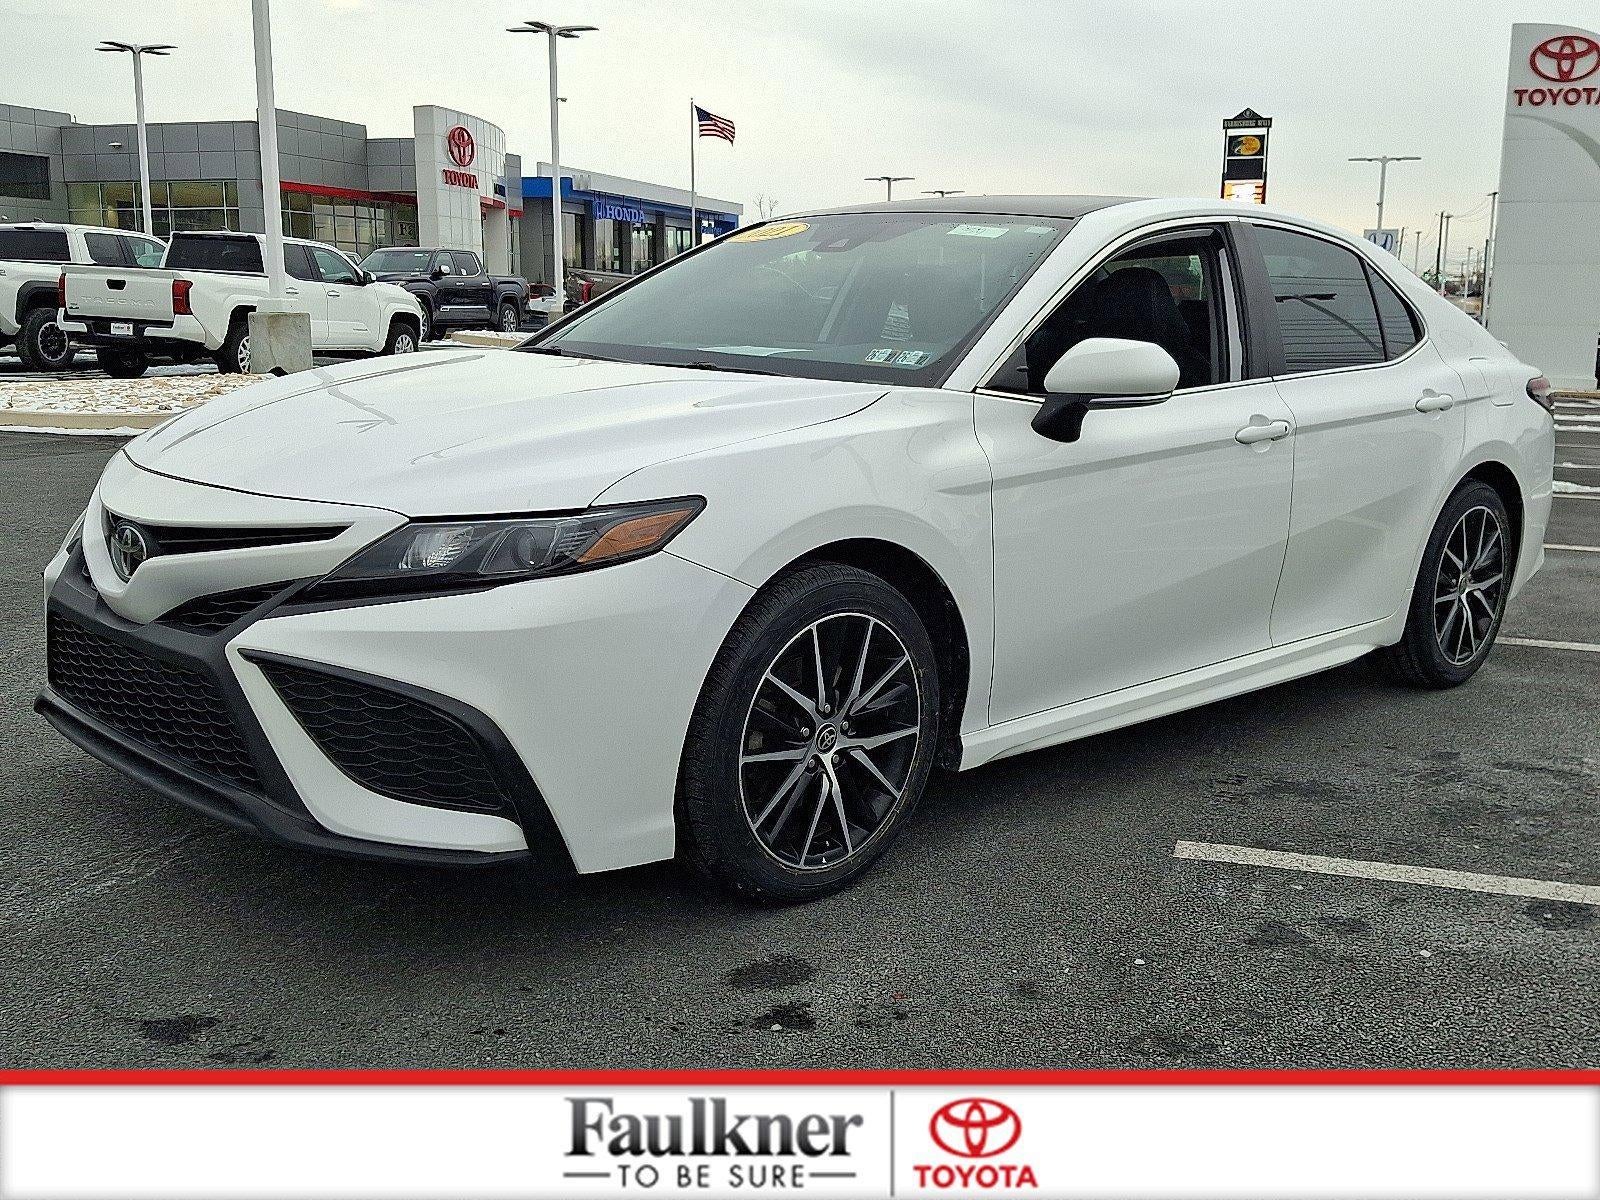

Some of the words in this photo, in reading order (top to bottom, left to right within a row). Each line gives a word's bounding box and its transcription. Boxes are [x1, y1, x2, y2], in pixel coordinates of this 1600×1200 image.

[1513, 87, 1600, 107] TOYOT
[442, 168, 479, 190] TOYOTA
[605, 205, 645, 223] HONDA
